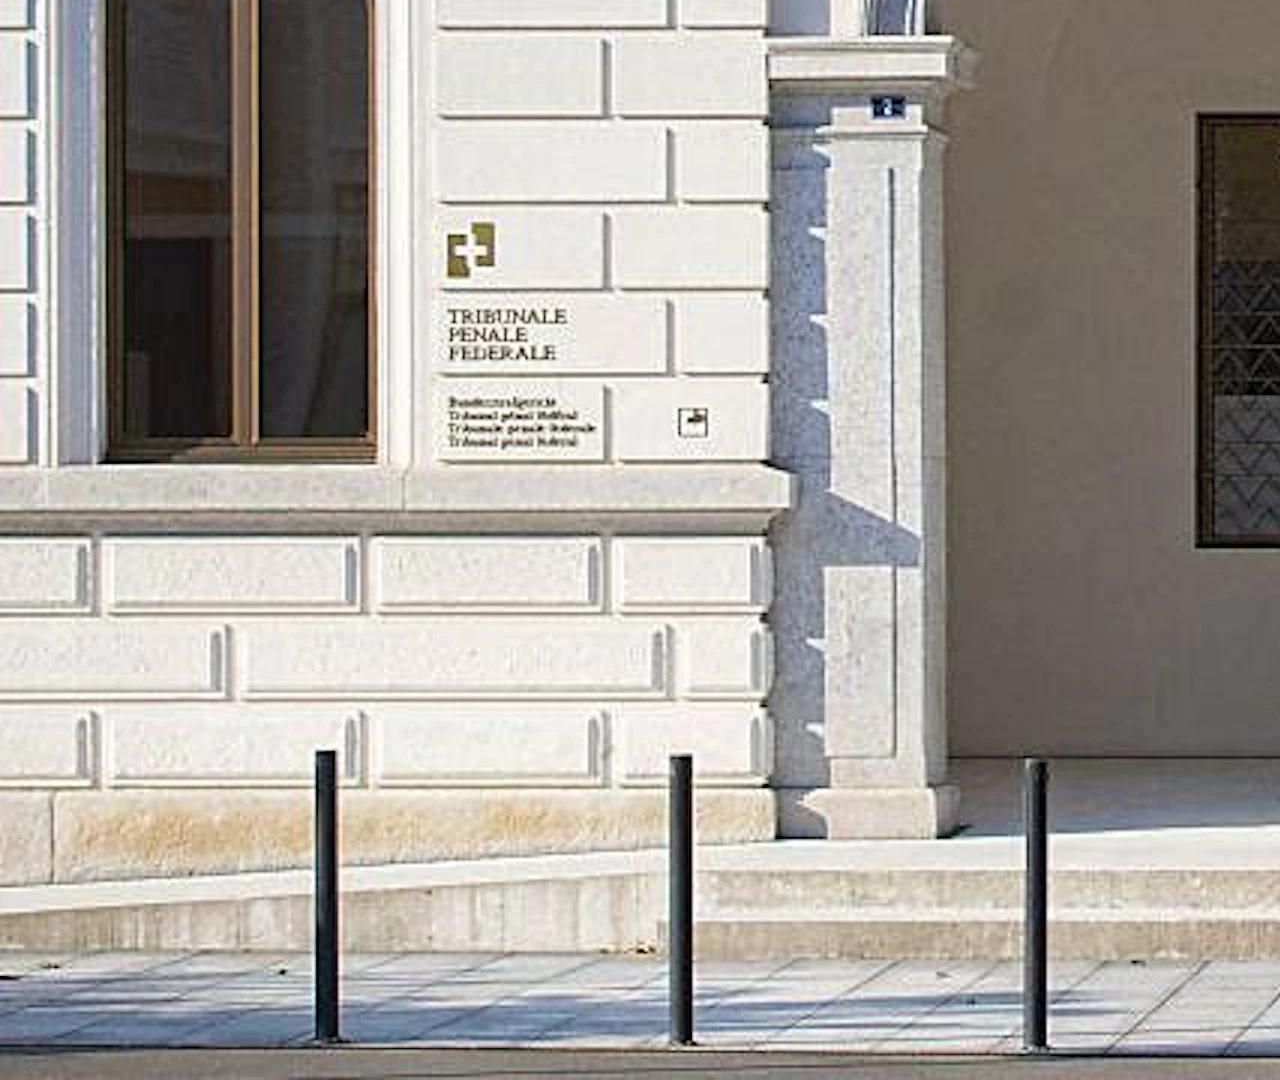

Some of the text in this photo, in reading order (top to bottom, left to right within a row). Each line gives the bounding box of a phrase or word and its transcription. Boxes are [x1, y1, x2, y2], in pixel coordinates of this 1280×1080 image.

[447, 308, 568, 324] TRIBUNALE
[449, 327, 528, 342] PENALE
[449, 345, 556, 360] FEDERALE
